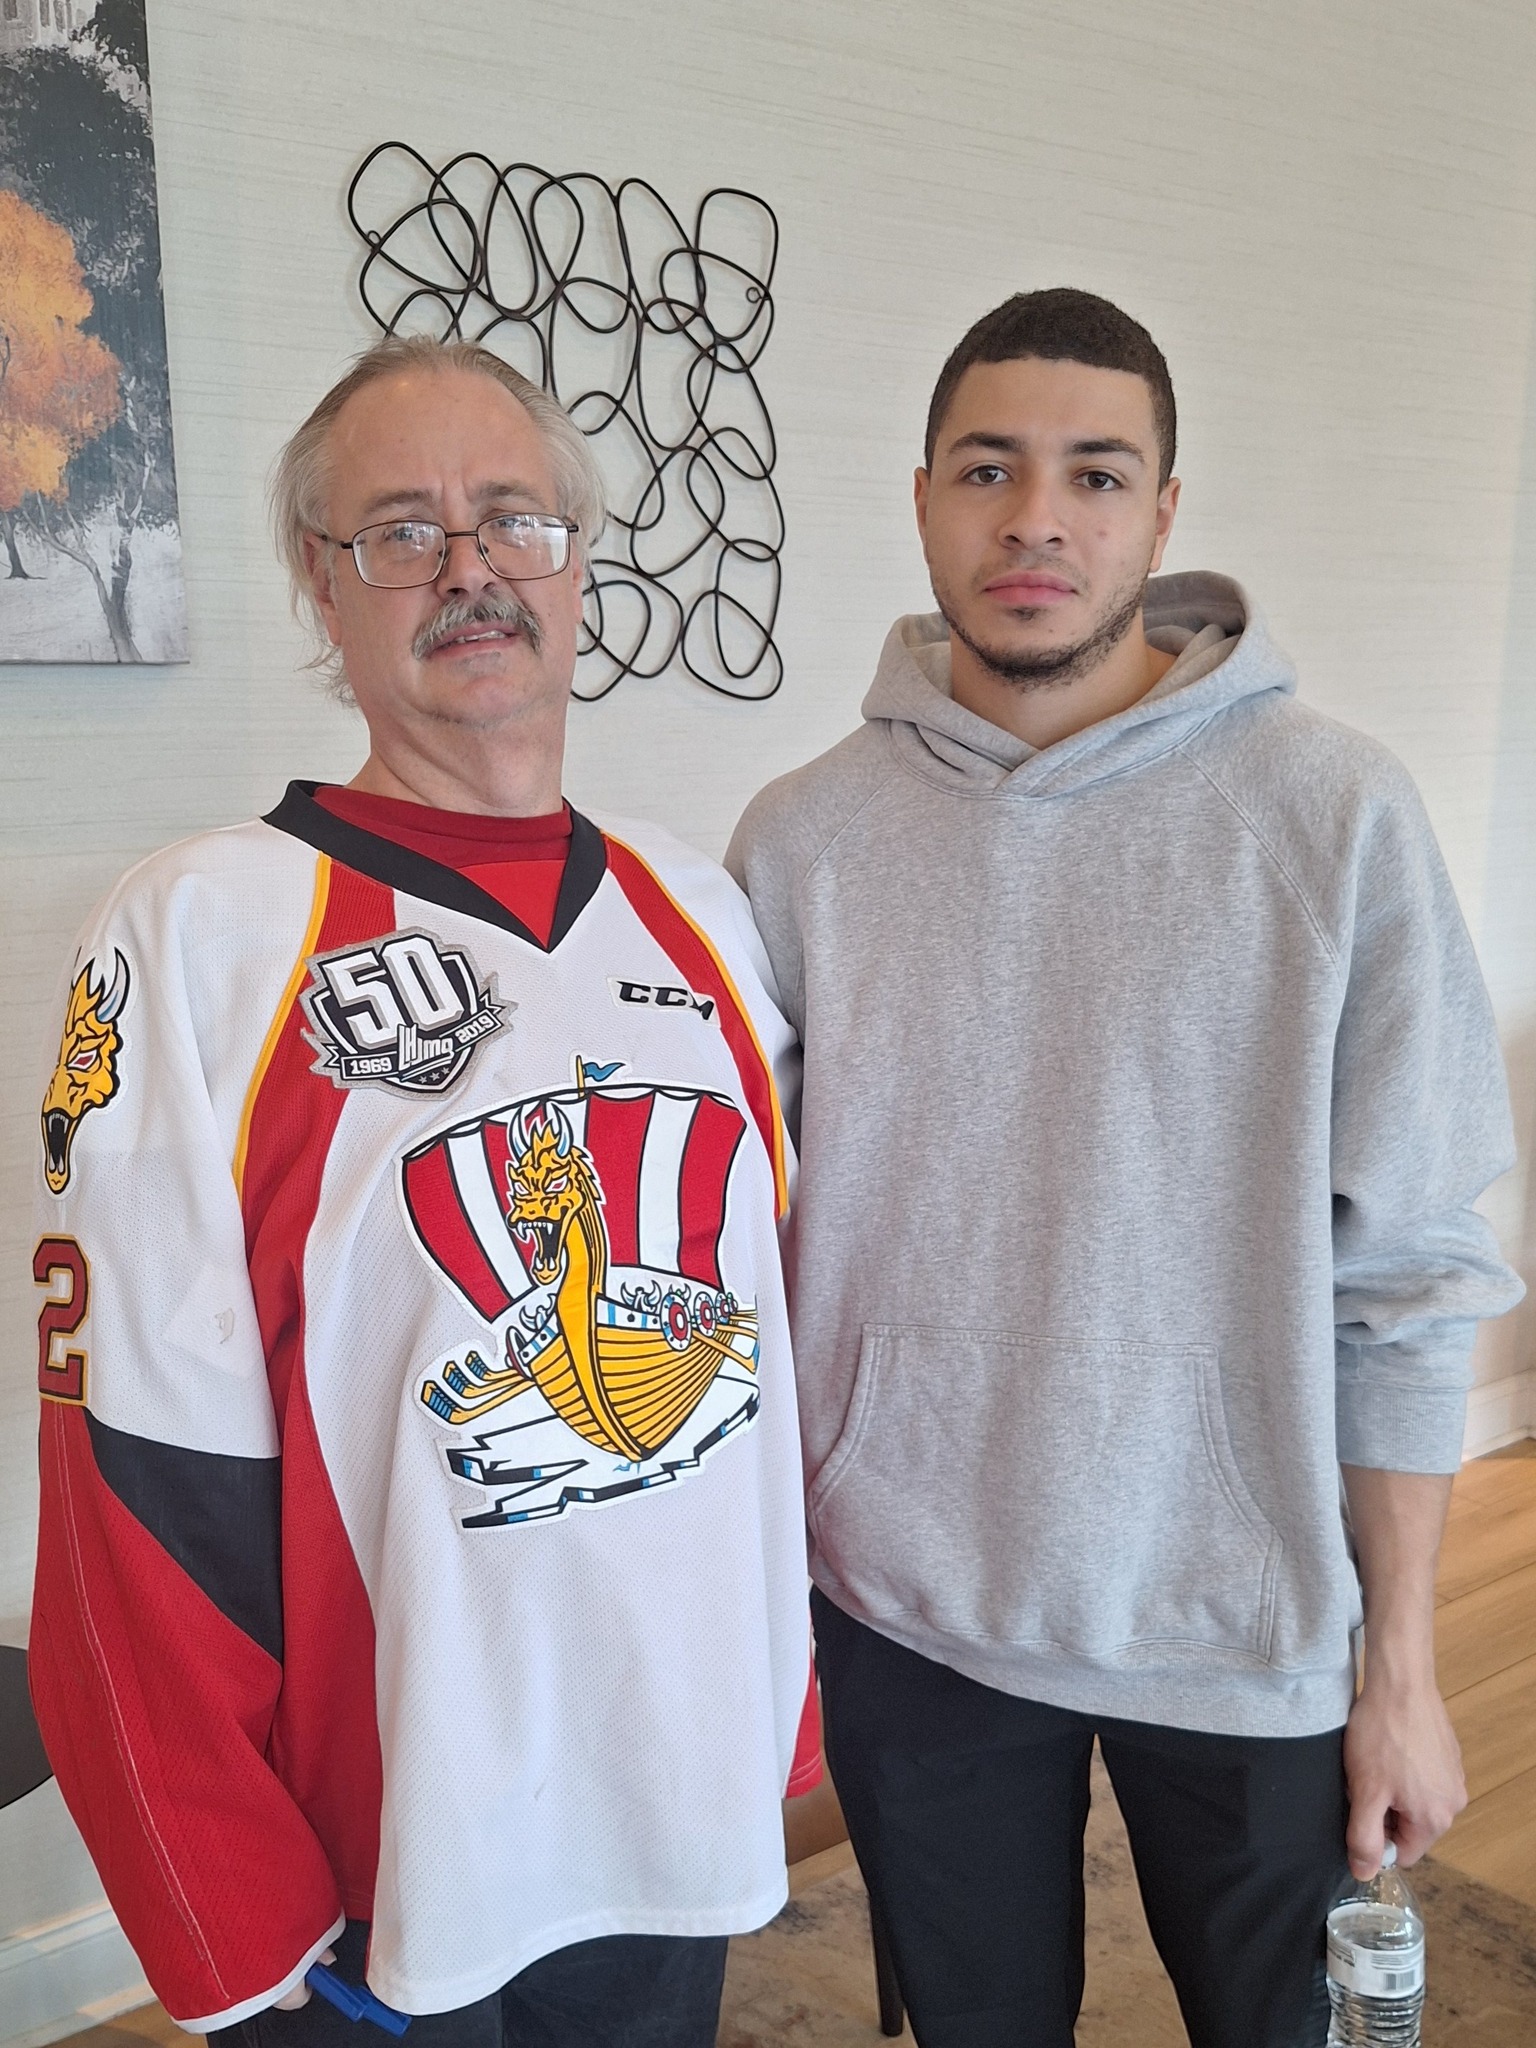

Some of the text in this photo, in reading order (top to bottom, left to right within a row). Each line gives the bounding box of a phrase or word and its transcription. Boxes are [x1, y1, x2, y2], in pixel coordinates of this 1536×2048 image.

[321, 935, 465, 1049] 50
[349, 1056, 393, 1075] 1969
[454, 1015, 495, 1043] 2019
[33, 1232, 91, 1406] 2
